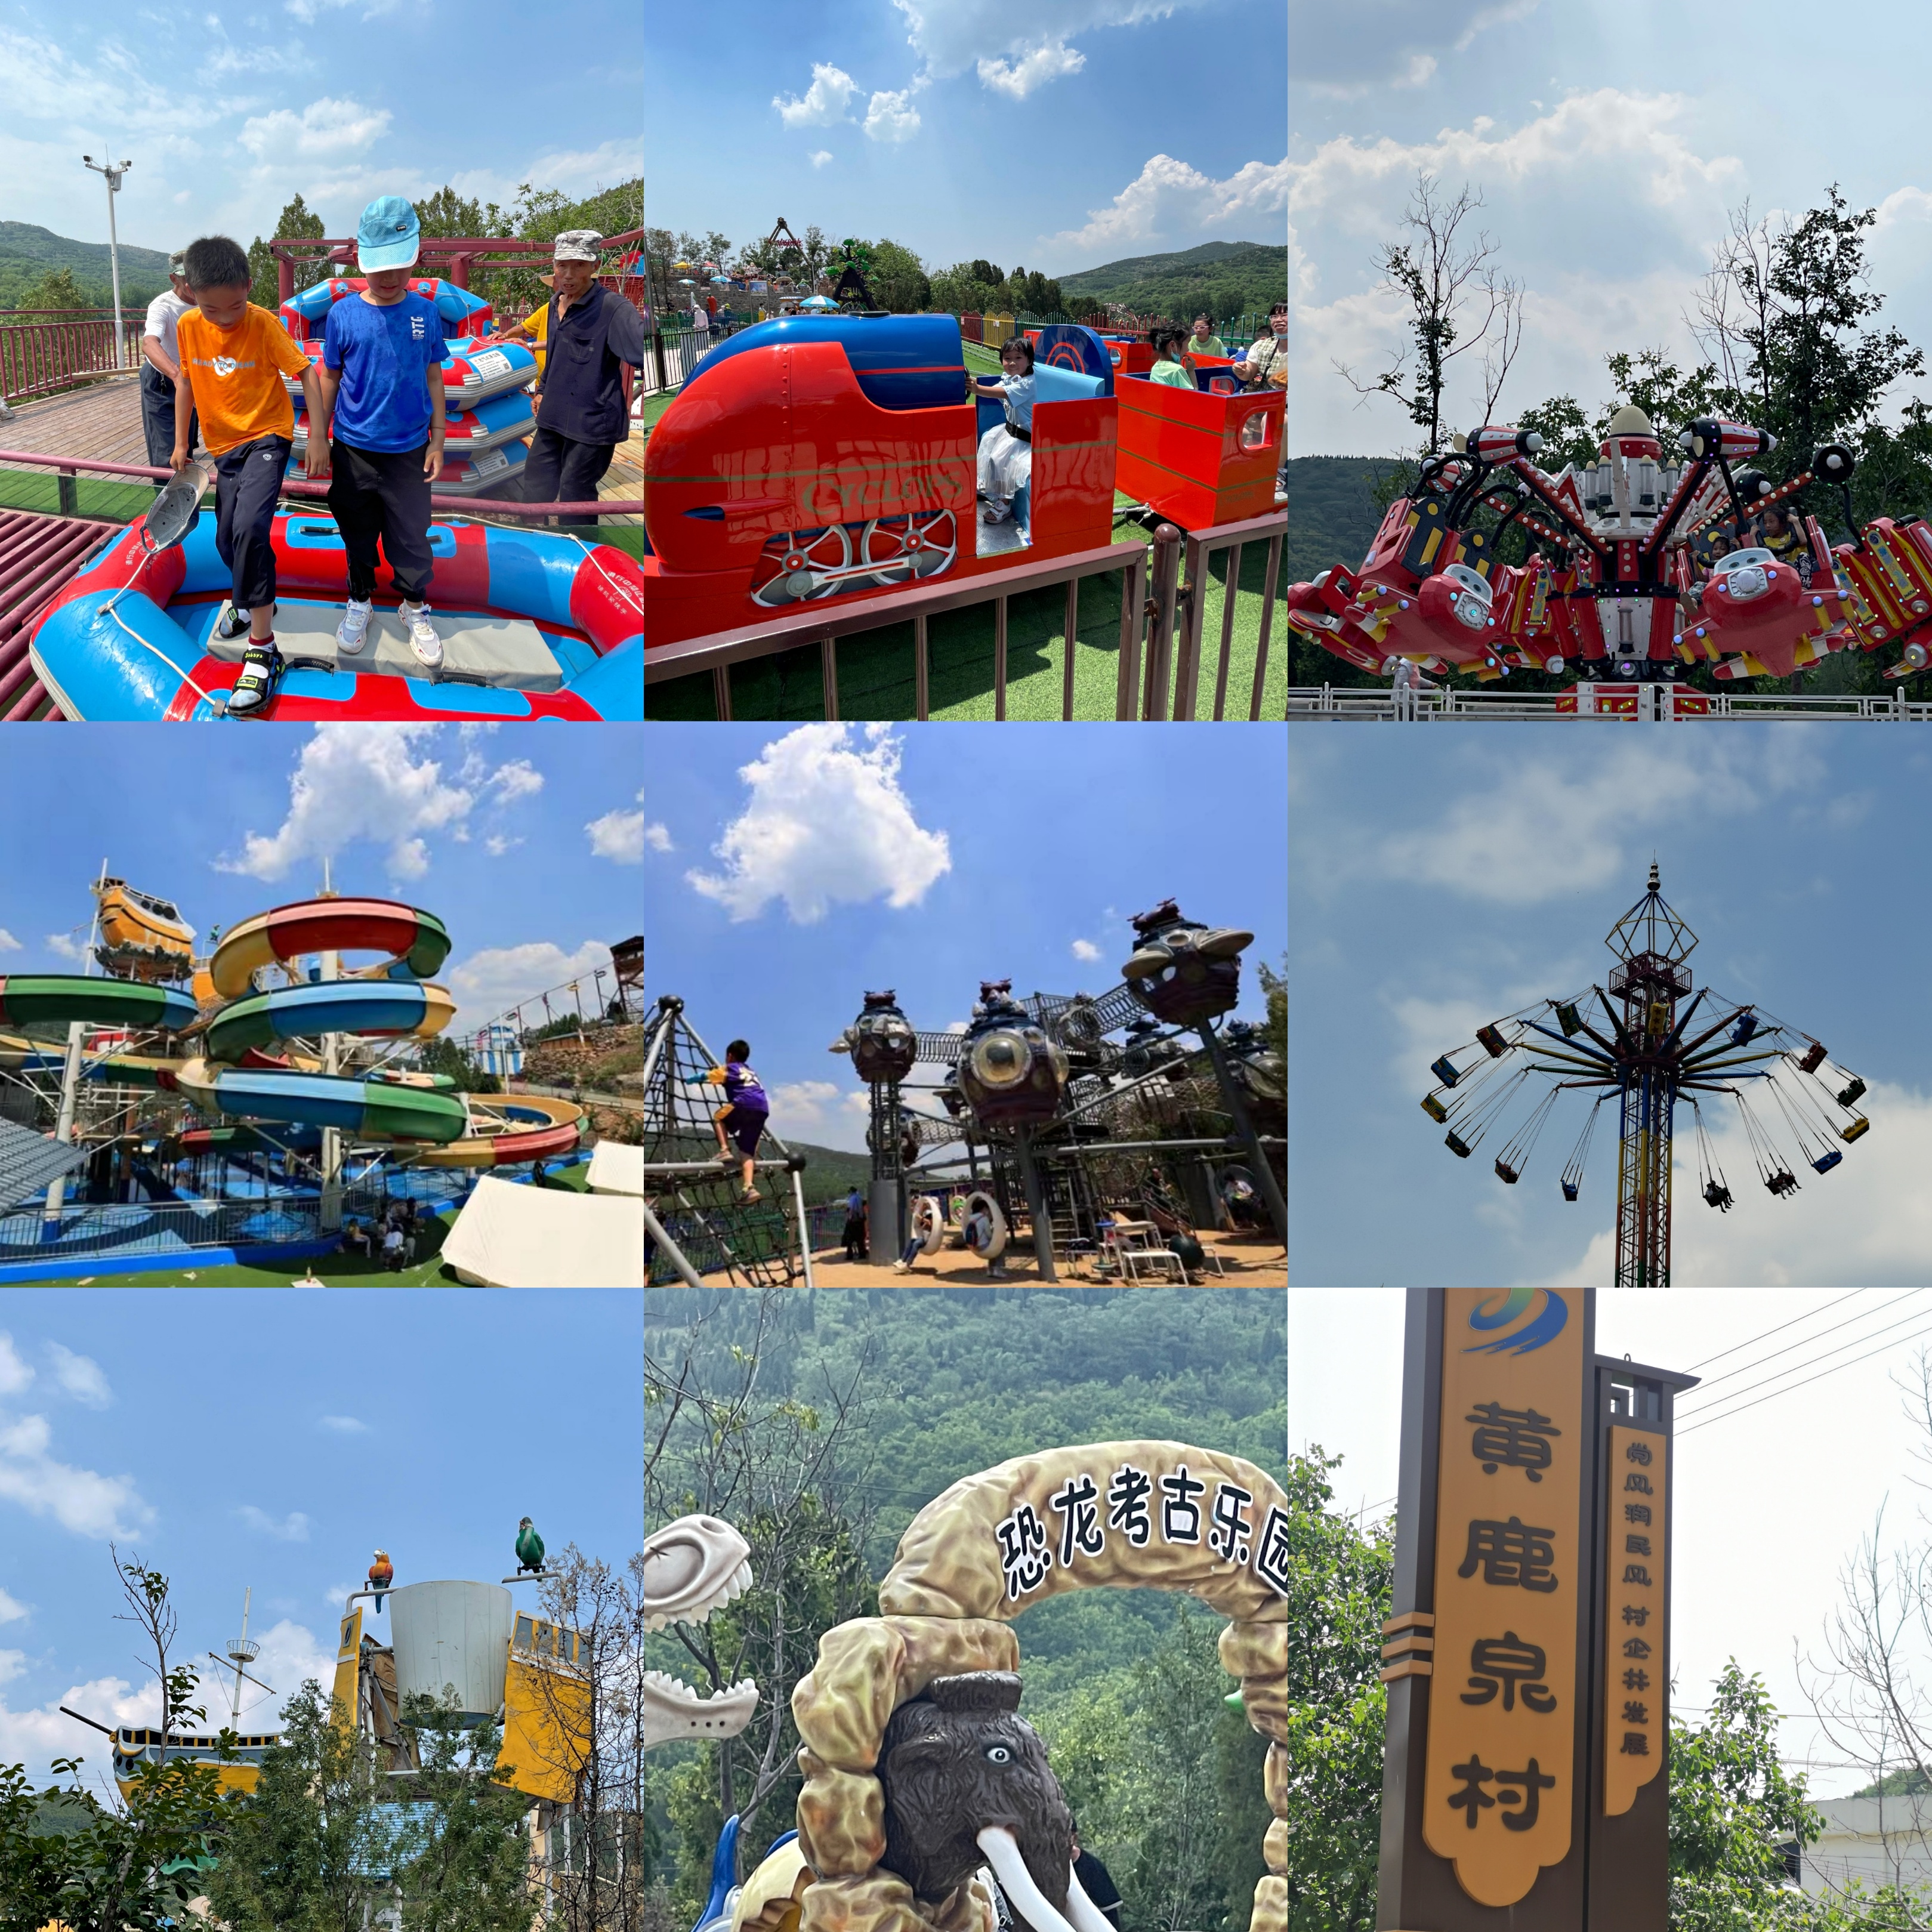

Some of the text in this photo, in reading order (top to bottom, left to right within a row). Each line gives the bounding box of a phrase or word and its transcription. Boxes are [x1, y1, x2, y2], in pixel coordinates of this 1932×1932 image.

[802, 471, 963, 516] CYCLOPS
[1447, 1401, 1562, 1832] 黄鹿泉村
[1619, 1442, 1653, 1756] 党风润民风 村企共发展
